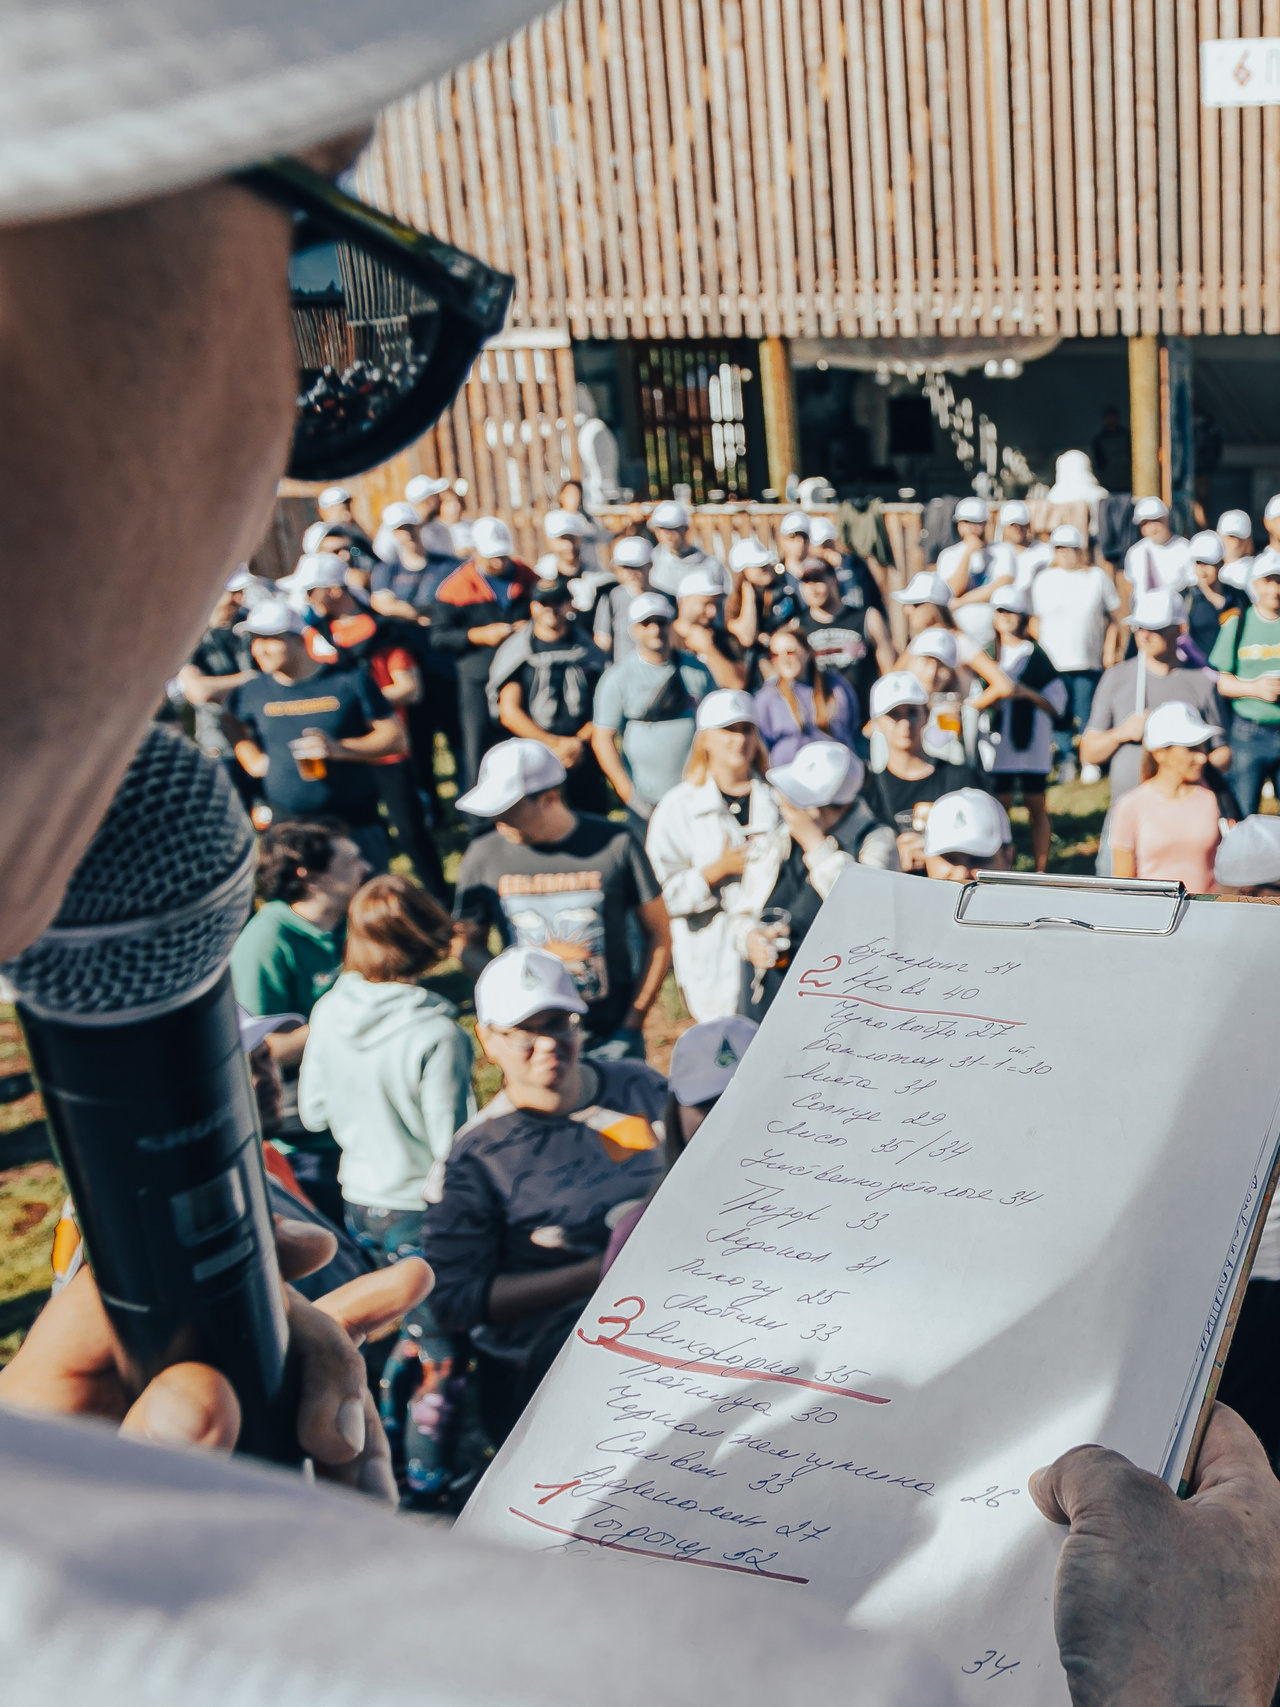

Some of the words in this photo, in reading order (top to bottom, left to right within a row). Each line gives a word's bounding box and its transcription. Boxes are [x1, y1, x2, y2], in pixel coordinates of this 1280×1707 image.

[1233, 48, 1253, 88] 6
[800, 955, 842, 987] 2
[943, 984, 980, 1001] 40
[966, 1023, 1016, 1039] 27
[792, 1092, 882, 1125] Солнце
[901, 1111, 947, 1127] 29
[1000, 1190, 1045, 1207] 34
[846, 1212, 889, 1230] 33
[706, 1228, 832, 1257] Ледокол
[668, 1258, 783, 1308] Пикачу
[797, 1289, 851, 1306] 25
[800, 1323, 843, 1342] 33
[814, 1365, 872, 1384] 35
[791, 1406, 839, 1424] 30
[749, 1473, 794, 1495] 33
[572, 1465, 768, 1527] Адреналин
[775, 1520, 832, 1544] 27
[960, 1485, 1021, 1508] 26
